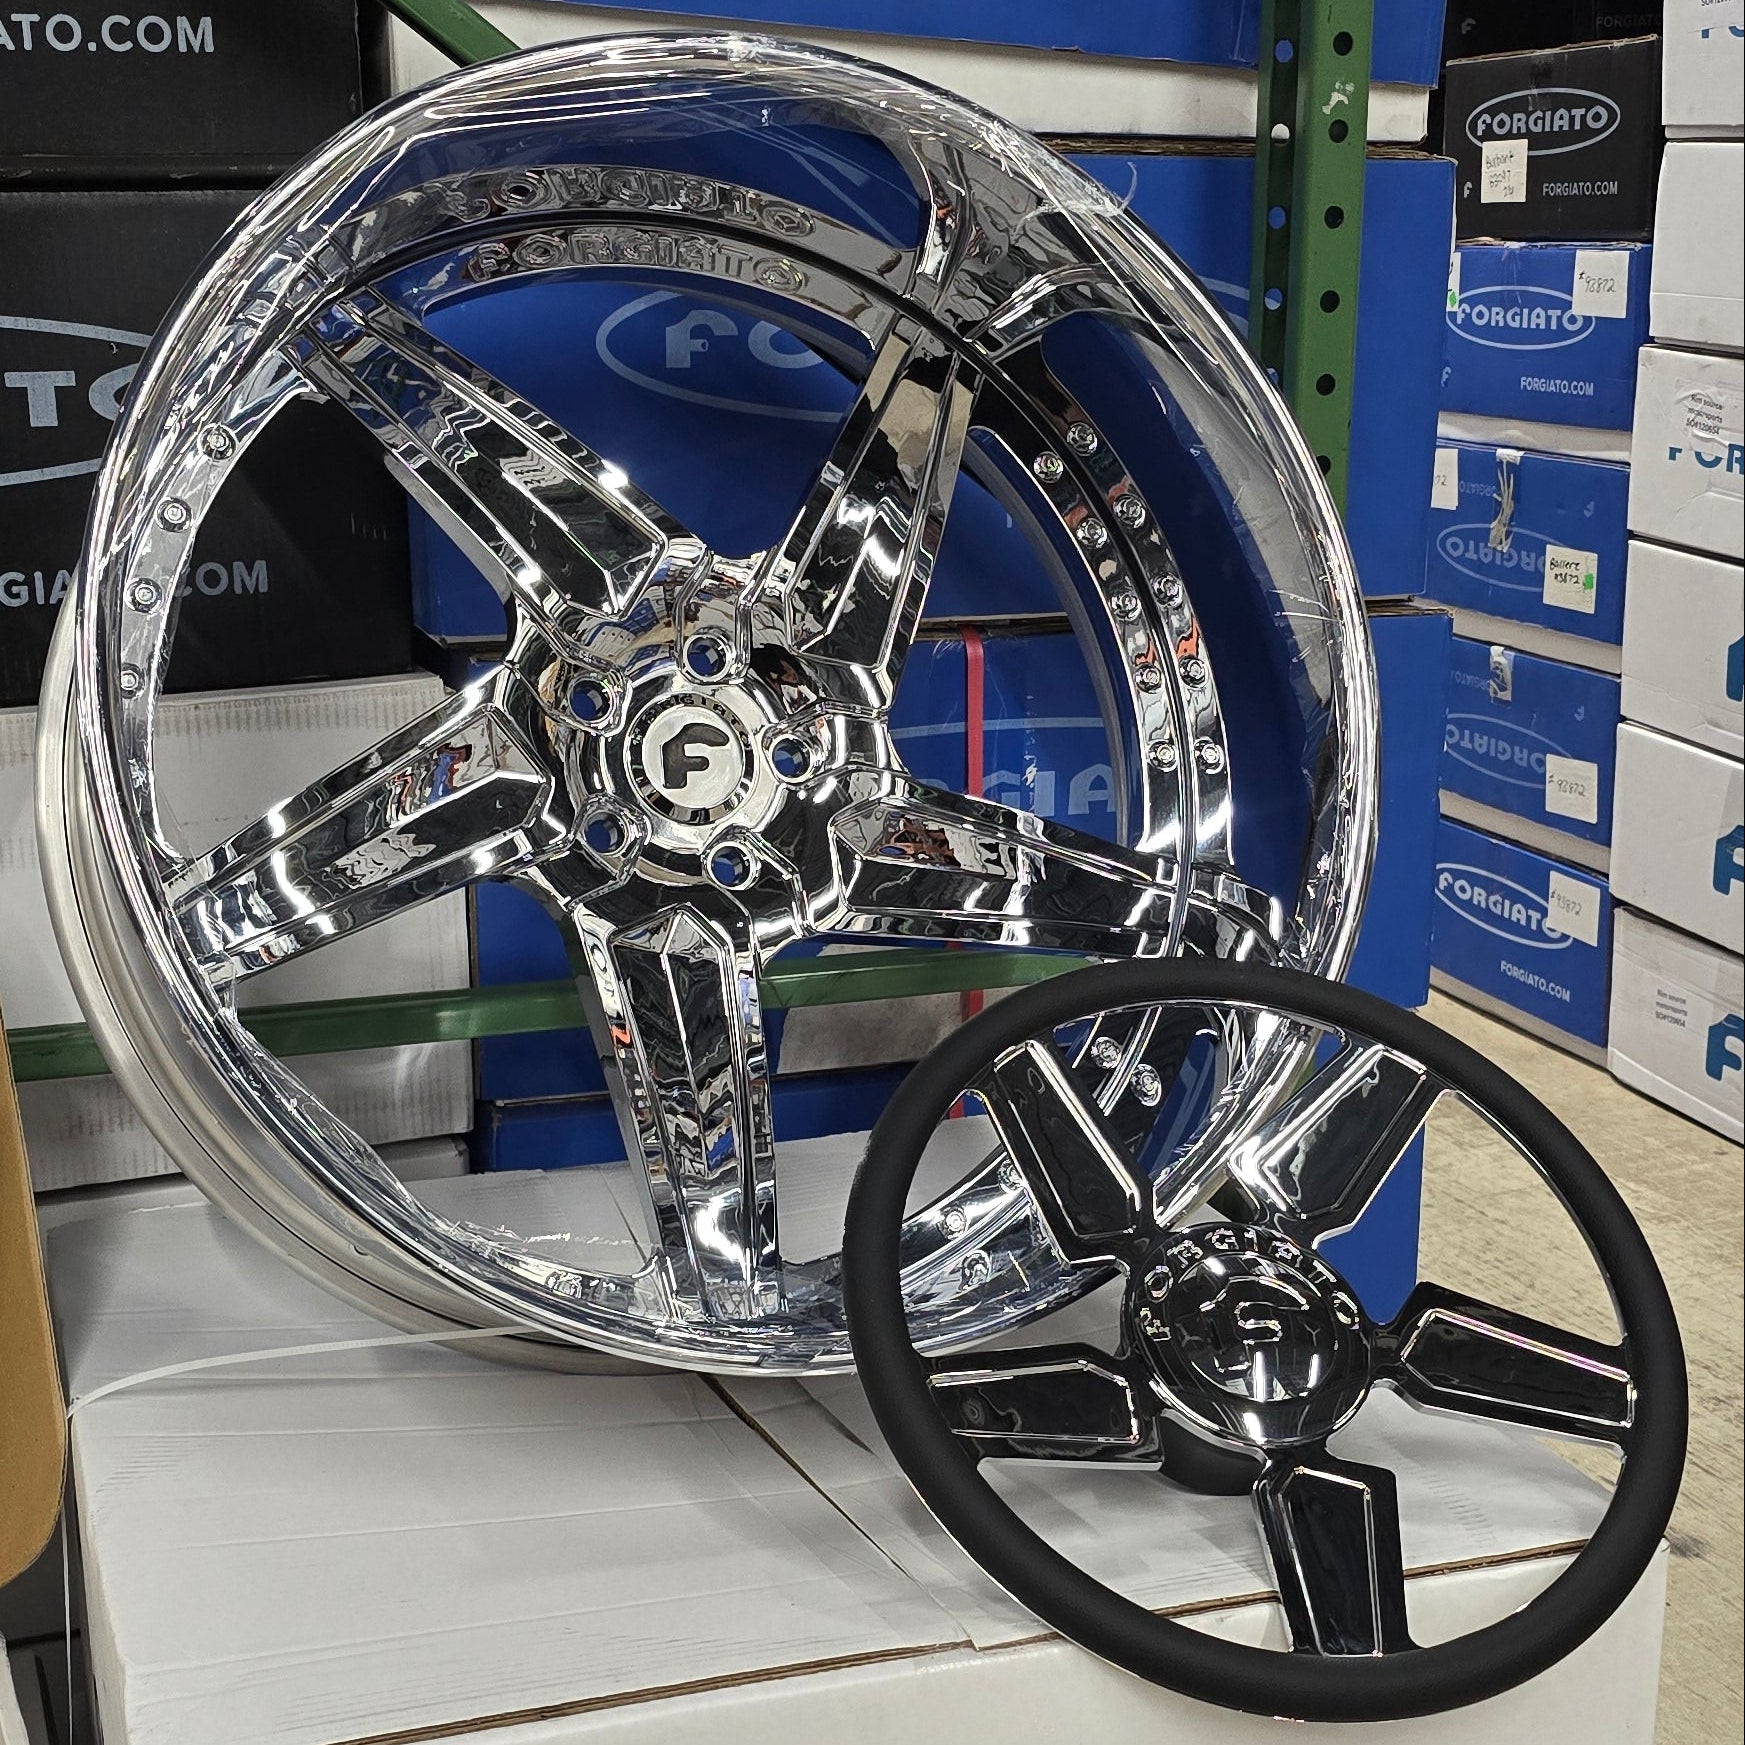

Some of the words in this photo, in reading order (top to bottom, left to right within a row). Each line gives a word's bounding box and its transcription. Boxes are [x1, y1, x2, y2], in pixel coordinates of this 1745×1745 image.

[1476, 104, 1608, 136] FORGIATO
[1542, 181, 1618, 197] FORGIATO.COM
[466, 229, 808, 294] FORGIATO
[1456, 304, 1584, 332] FORGIATO
[1520, 376, 1594, 396] FORGIATO.COM
[1459, 480, 1497, 497] ORGIATO
[1445, 536, 1545, 572] RGIATO
[662, 722, 730, 790] F
[1446, 724, 1545, 774] ORGIATO
[1500, 960, 1571, 1003] FORGIATO.COM
[1140, 1227, 1360, 1342] FORGIATO
